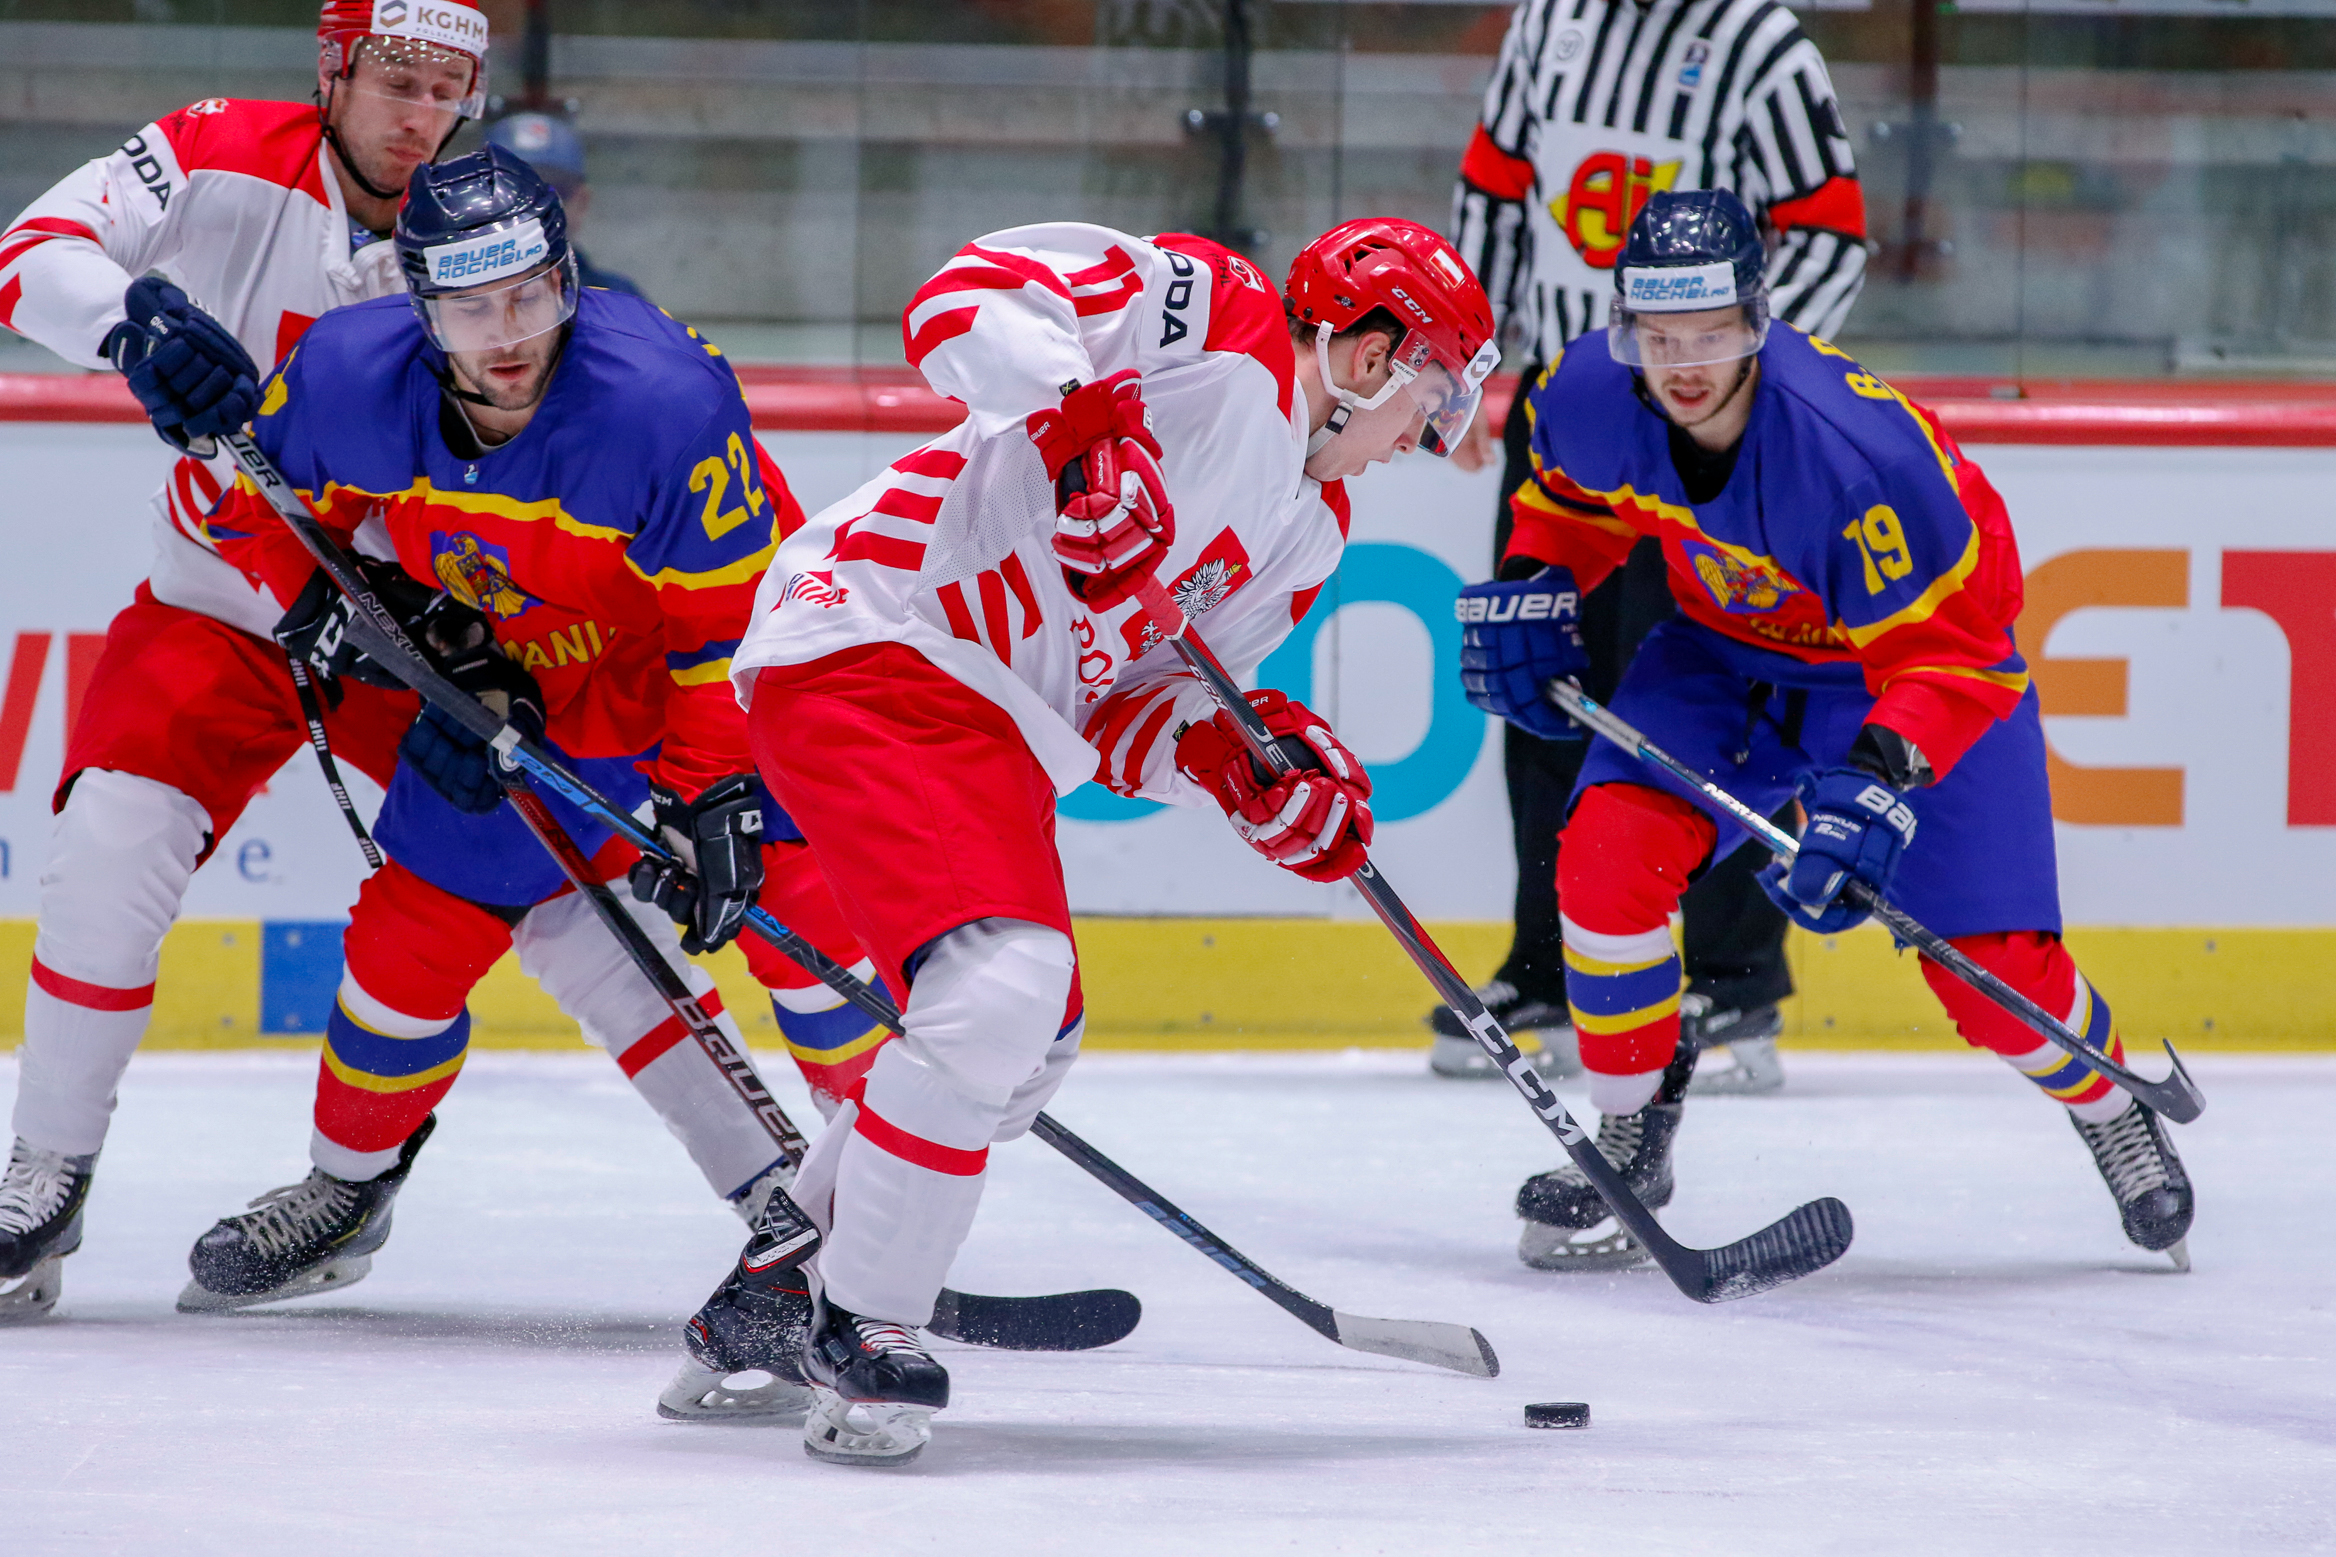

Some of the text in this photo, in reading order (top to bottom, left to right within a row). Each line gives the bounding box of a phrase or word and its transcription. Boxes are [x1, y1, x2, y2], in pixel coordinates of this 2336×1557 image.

[415, 28, 455, 40] POLSKA
[417, 7, 484, 43] KGHM
[438, 239, 516, 268] BAUER
[1062, 244, 1144, 318] 11
[1154, 243, 1194, 349] ODA
[1632, 276, 1705, 289] BAUER
[1391, 286, 1433, 324] CCM
[688, 431, 765, 542] 22
[1841, 503, 1914, 596] 19
[1454, 591, 1578, 623] BAUER
[359, 591, 431, 669] NEXU
[308, 719, 328, 751] IIHF
[1812, 814, 1862, 833] NEXUS
[1471, 1005, 1588, 1146] CCM
